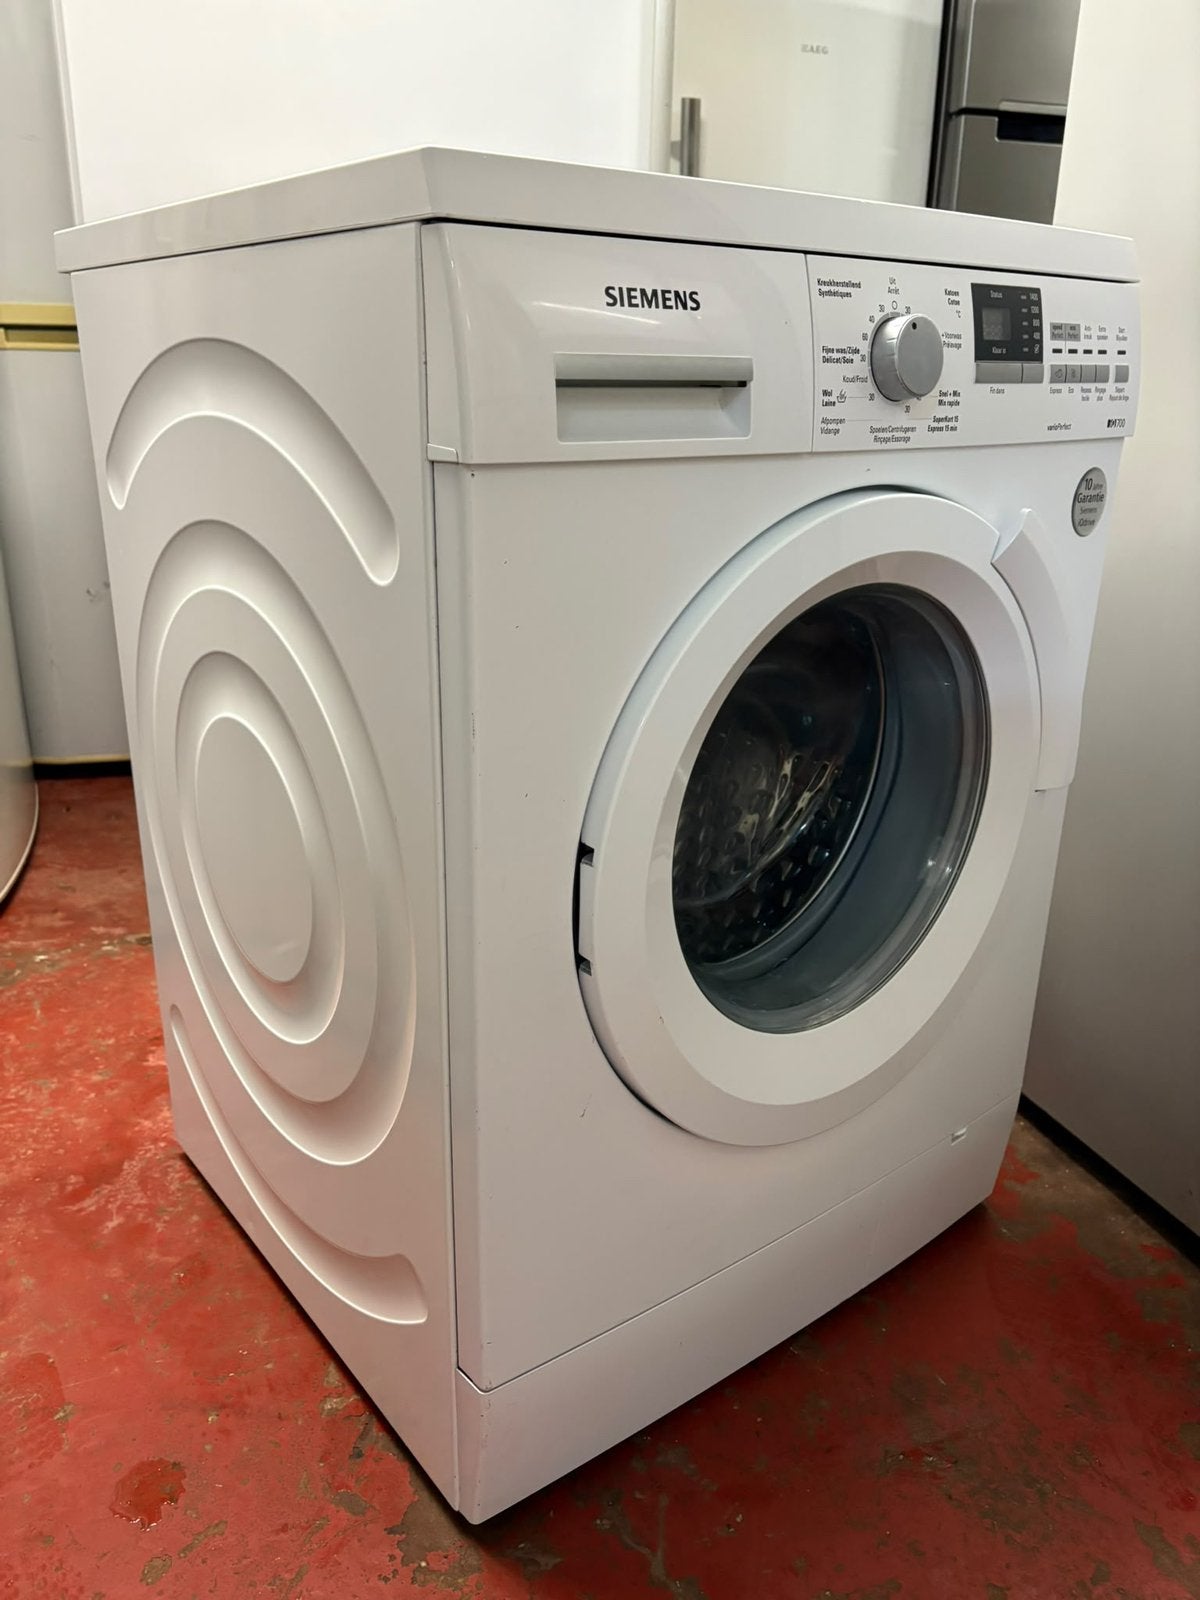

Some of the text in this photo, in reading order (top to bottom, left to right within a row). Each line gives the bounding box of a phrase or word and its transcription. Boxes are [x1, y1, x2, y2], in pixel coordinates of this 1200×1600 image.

[817, 278, 862, 288] Kreukherstellend
[944, 288, 960, 296] Katoen
[990, 290, 1003, 298] Status
[604, 286, 700, 311] SIEMENS
[948, 298, 960, 306] Coton
[878, 304, 885, 312] 30
[905, 306, 911, 314] 30
[869, 315, 875, 324] 40
[862, 332, 868, 341] 60
[822, 346, 860, 356] Fijne was/Zijde
[860, 354, 866, 362] 30
[842, 375, 868, 383] Koud/Froid
[822, 389, 832, 397] Wol
[868, 392, 875, 402] 30
[938, 390, 948, 398] Snel
[952, 390, 960, 398] Mix
[947, 399, 960, 408] rapide
[904, 405, 910, 414] 30
[820, 417, 846, 426] Afpompen
[928, 424, 944, 433] Express
[1047, 422, 1072, 431] varioPerfect
[820, 427, 840, 436] Vidange
[1084, 478, 1094, 490] 10
[1077, 491, 1104, 504] Garantie
